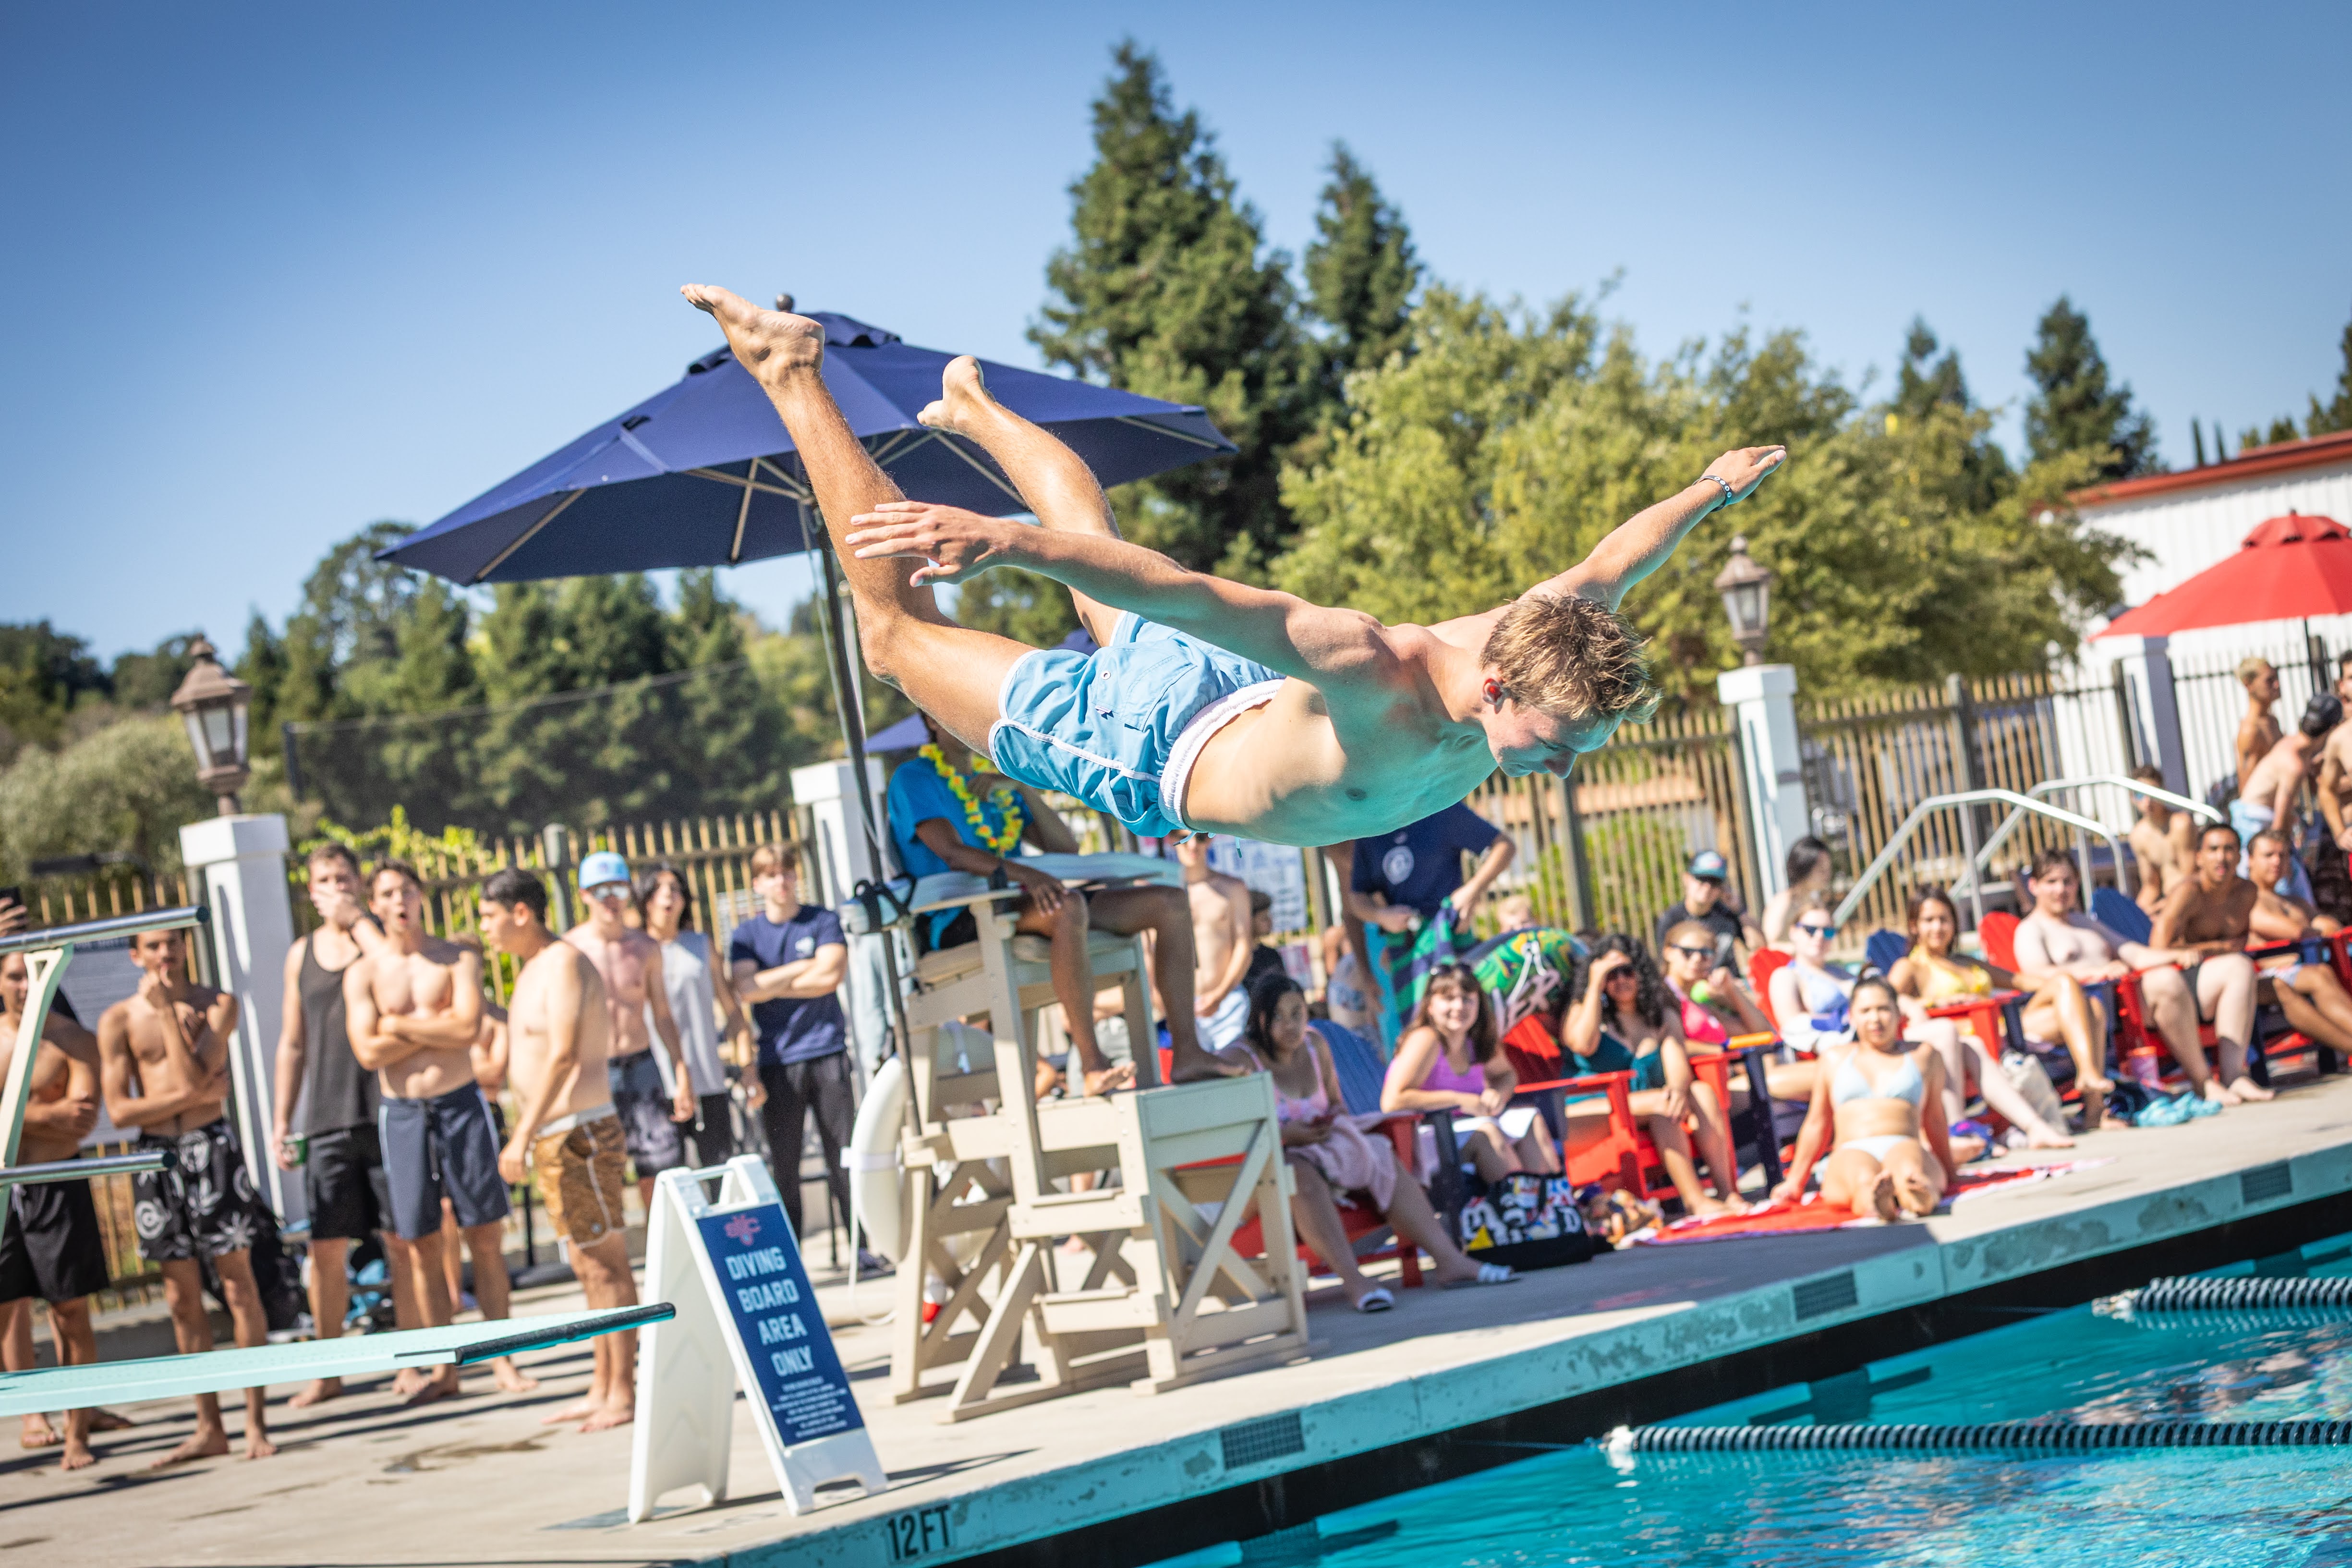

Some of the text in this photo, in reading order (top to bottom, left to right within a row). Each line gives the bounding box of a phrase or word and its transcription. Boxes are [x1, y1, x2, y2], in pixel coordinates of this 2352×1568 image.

[725, 1245, 787, 1281] DIVING
[736, 1278, 800, 1313] BOARD
[757, 1313, 808, 1345] AREA
[771, 1345, 814, 1377] ONLY
[888, 1505, 949, 1559] 12FT
